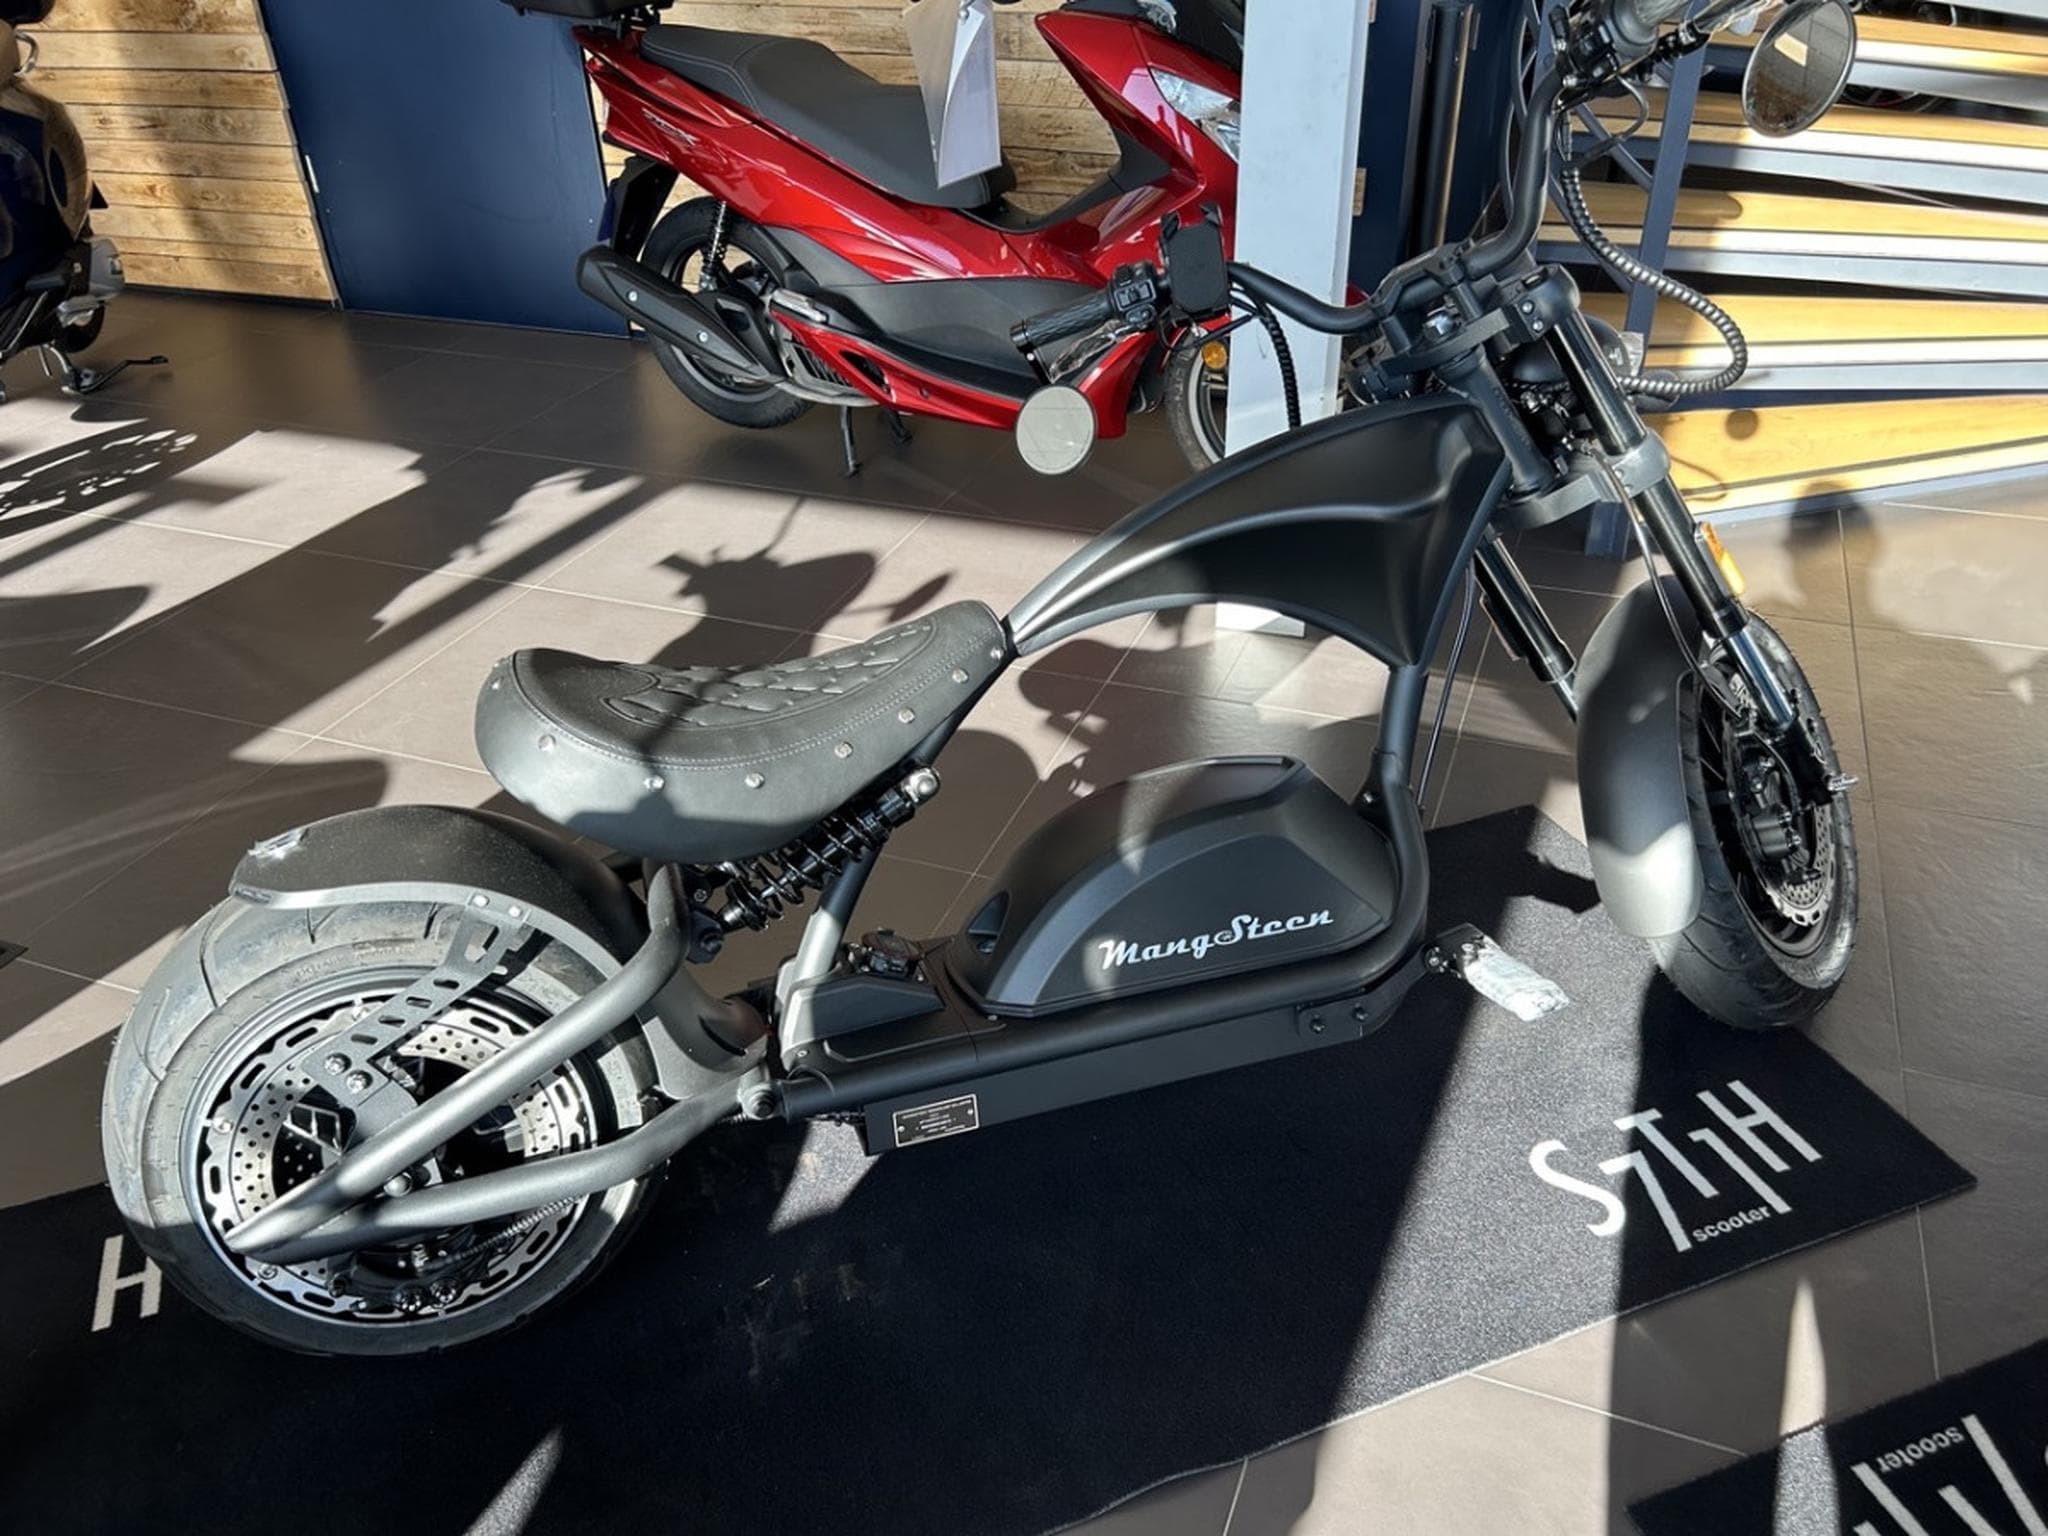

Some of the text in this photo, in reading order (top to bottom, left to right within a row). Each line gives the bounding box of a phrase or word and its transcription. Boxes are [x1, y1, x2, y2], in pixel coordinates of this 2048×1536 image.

[1099, 909, 1334, 970] MangSteen
[1692, 1206, 1771, 1242] scooter
[1876, 1426, 1965, 1473] scooter
